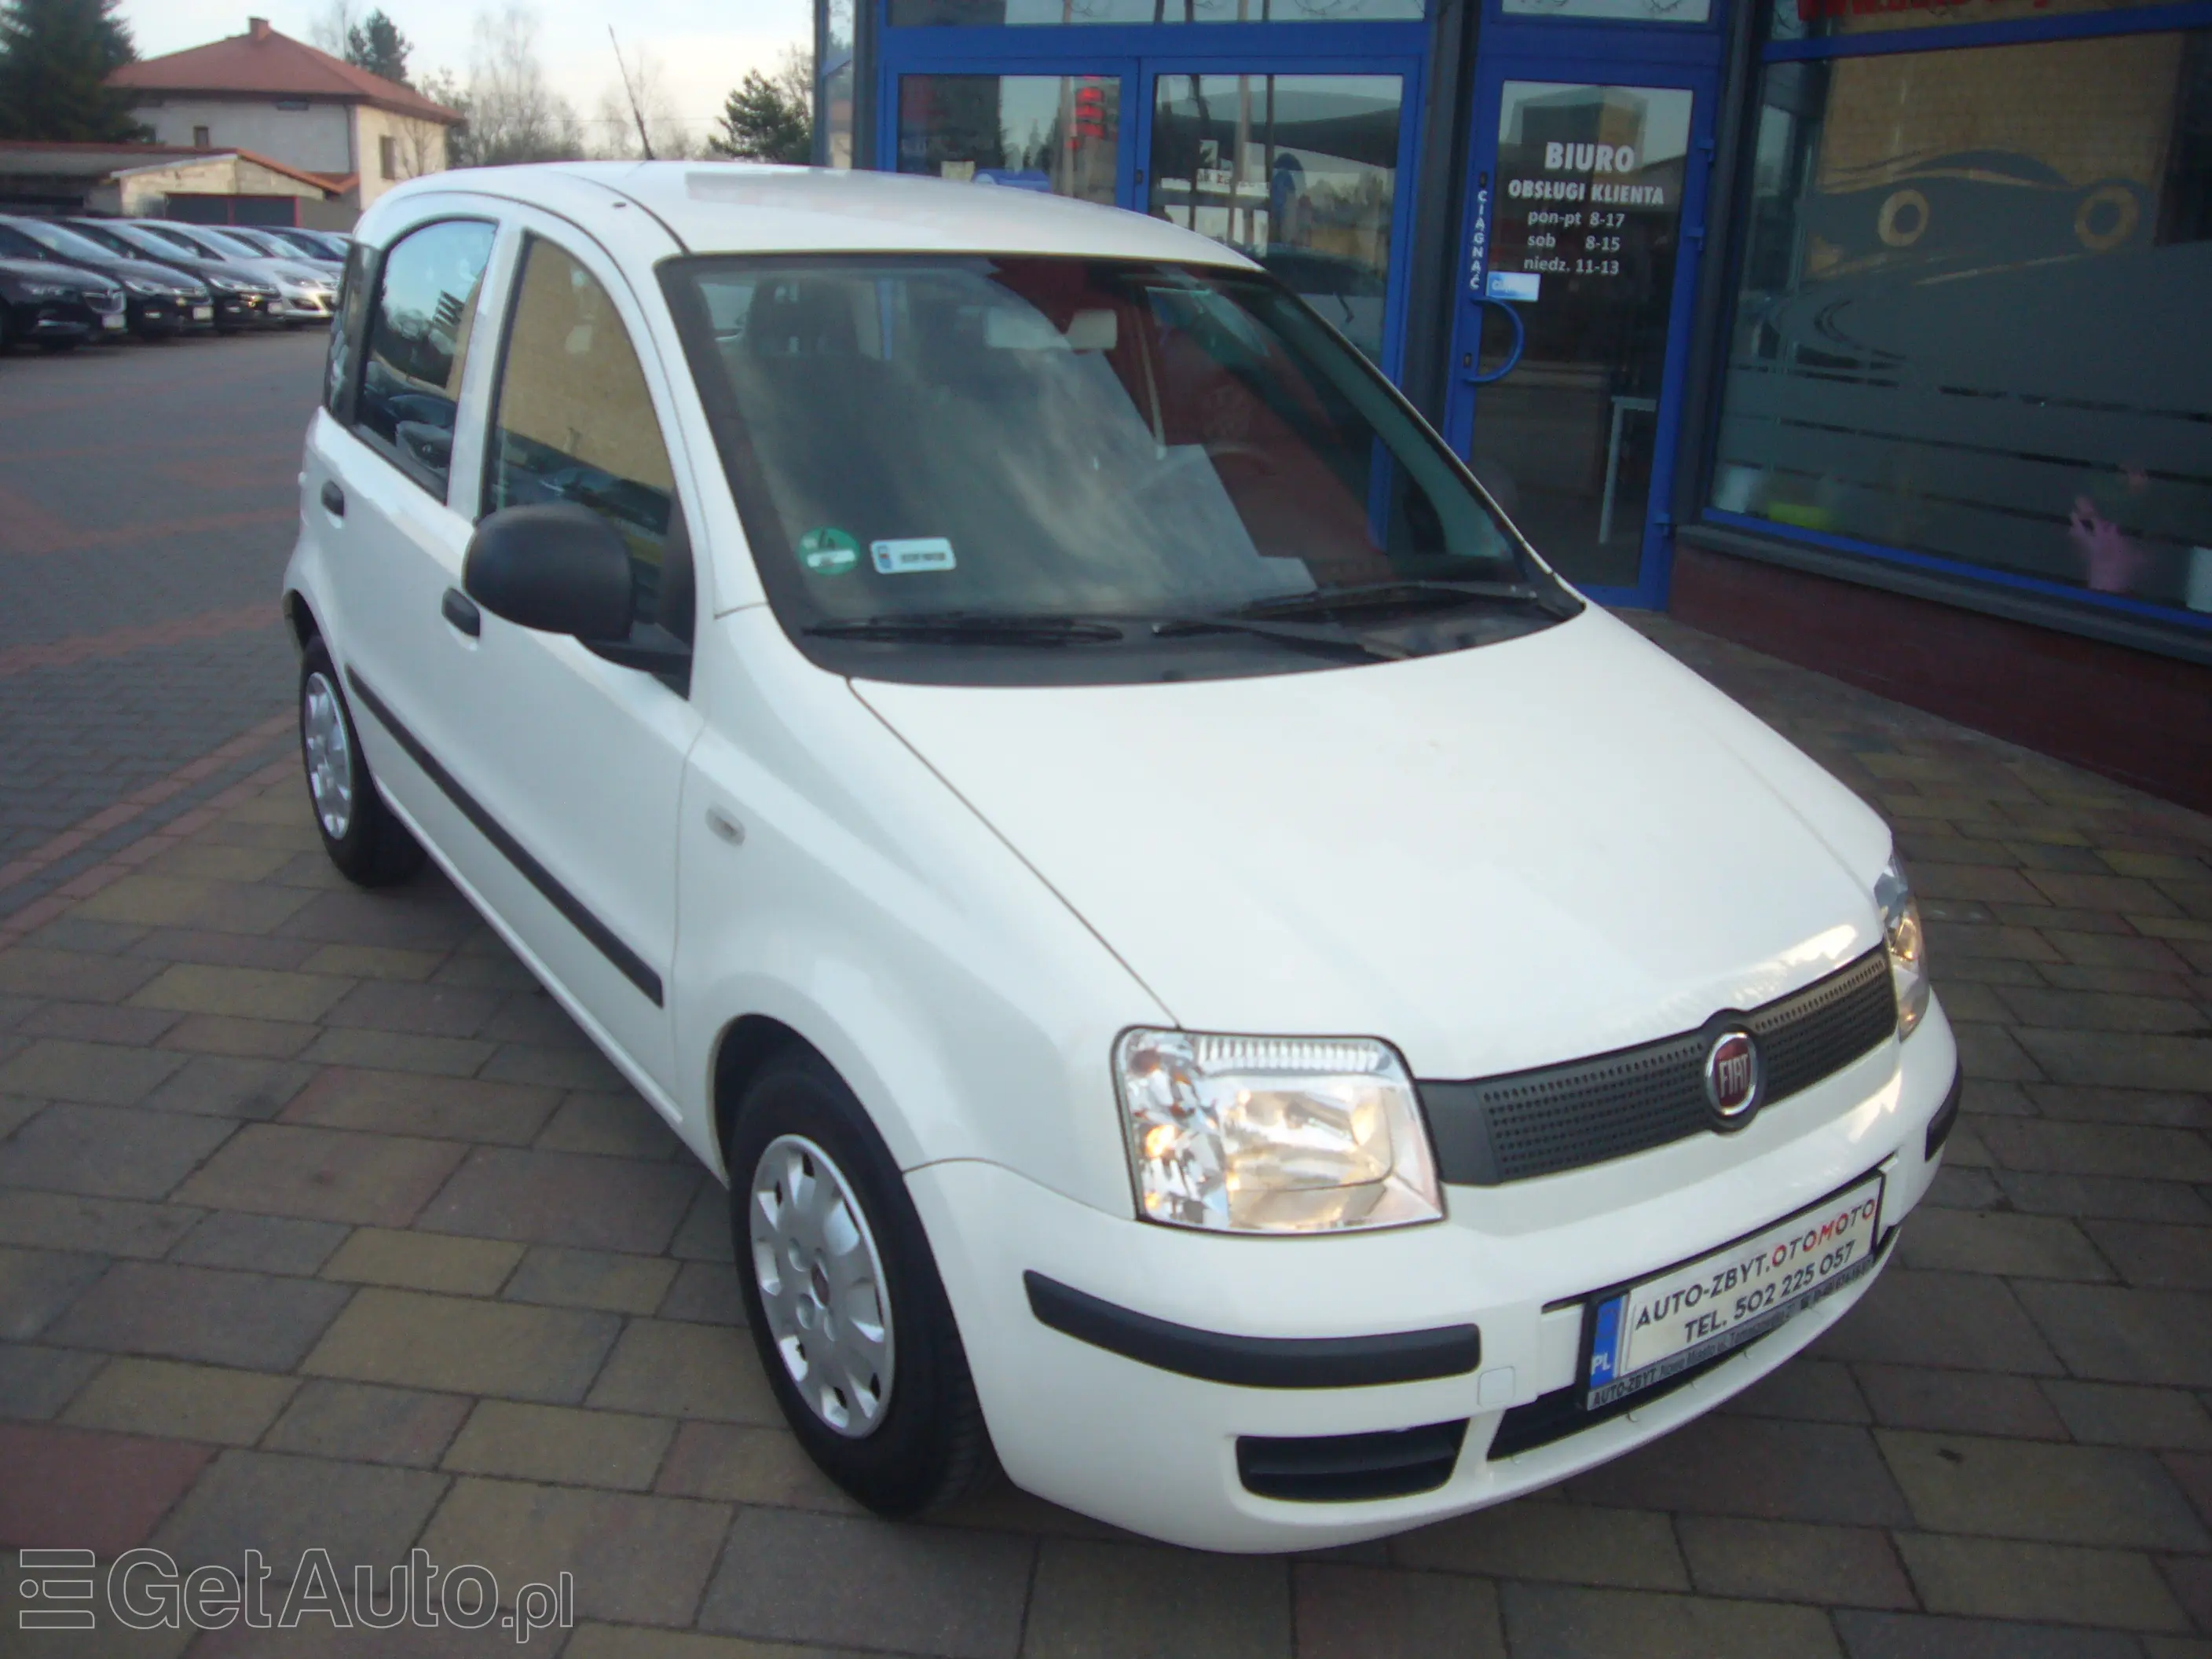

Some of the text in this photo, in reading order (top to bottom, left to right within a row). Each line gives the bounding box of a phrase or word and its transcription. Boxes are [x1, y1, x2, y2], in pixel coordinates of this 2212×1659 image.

[1544, 141, 1635, 173] BIURO
[1507, 179, 1664, 205] OBSŁUGI KLIENTA
[1527, 211, 1625, 228] pon-pt 8-17
[1526, 232, 1621, 251] sob 8-15
[1523, 255, 1620, 276] niedz. 11-13
[1719, 1053, 1749, 1099] FIAT
[1684, 1309, 1728, 1344] TEL.
[1734, 1283, 1777, 1320] 502
[1781, 1262, 1815, 1298] 225
[1819, 1239, 1856, 1275] 057
[1591, 1352, 1612, 1376] PL
